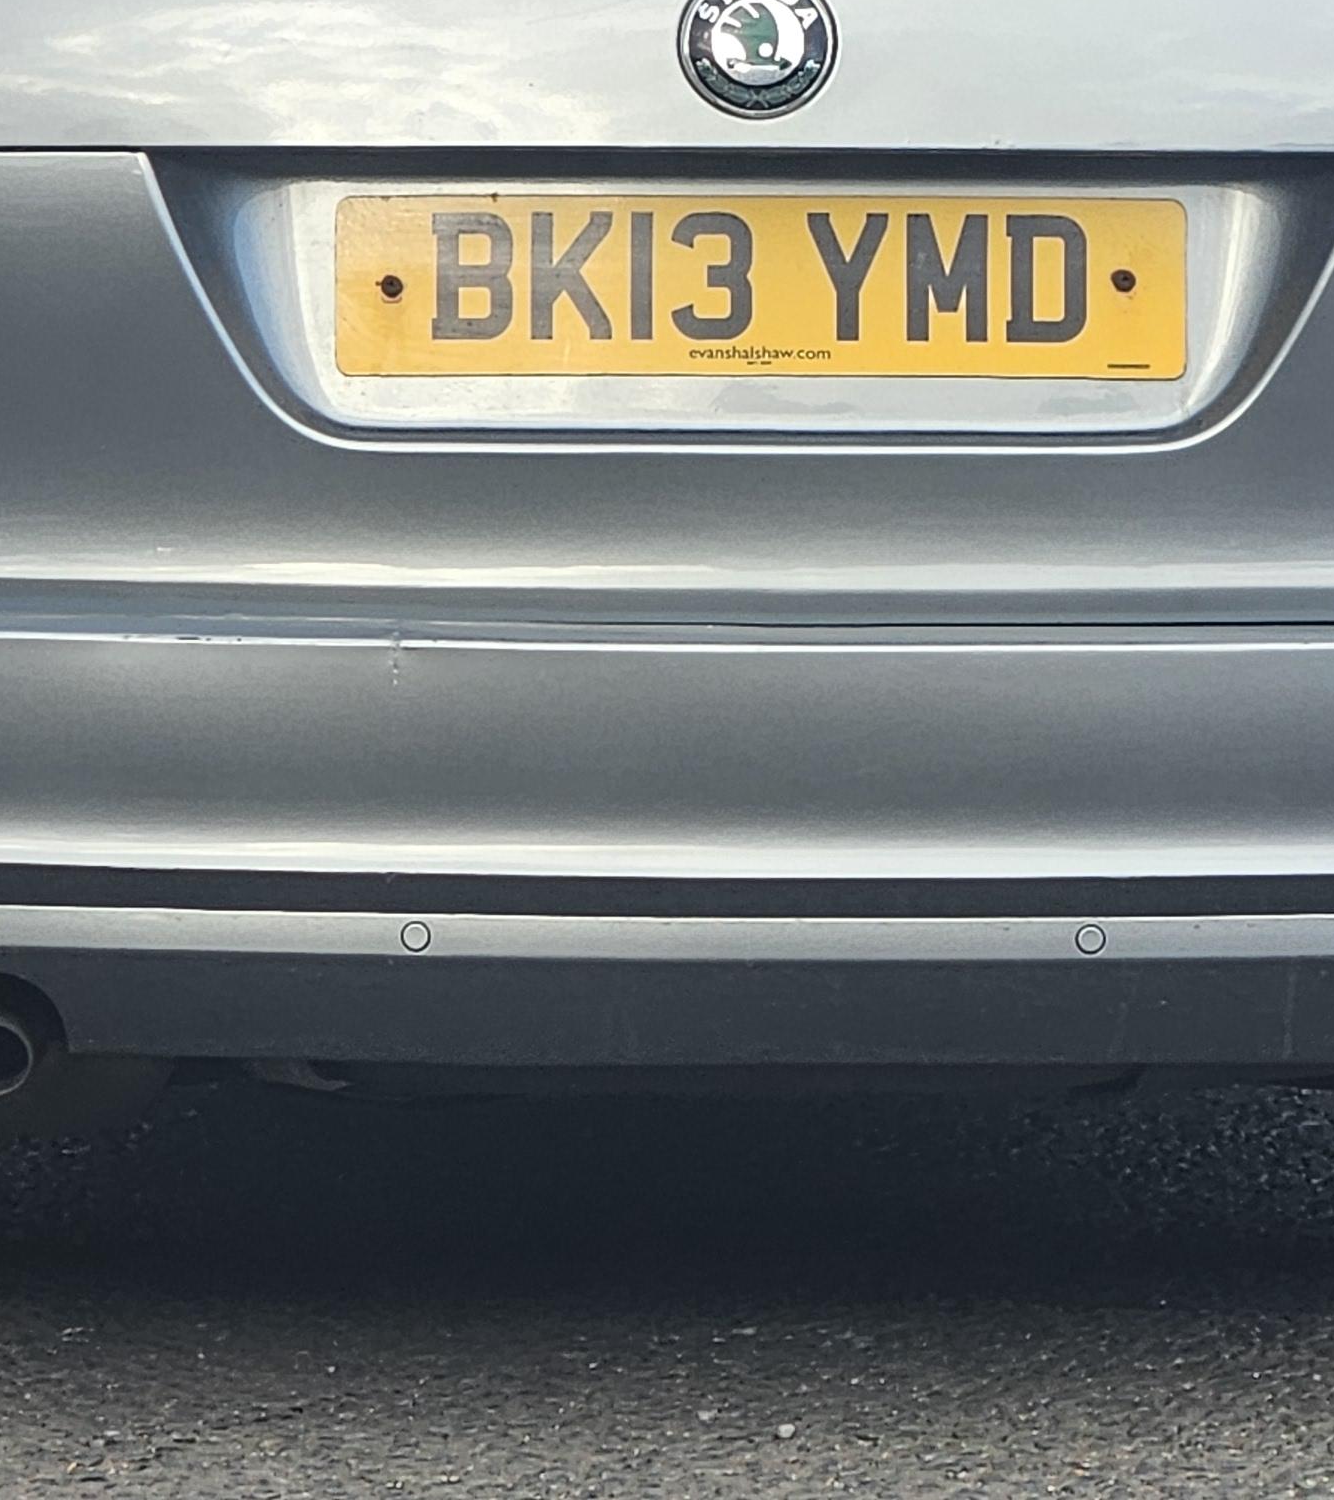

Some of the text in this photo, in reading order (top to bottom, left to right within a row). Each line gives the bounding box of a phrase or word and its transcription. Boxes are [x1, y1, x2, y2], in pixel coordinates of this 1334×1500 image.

[430, 211, 1089, 344] BK13 YMD
[688, 345, 832, 360] evanshalshaw.com
